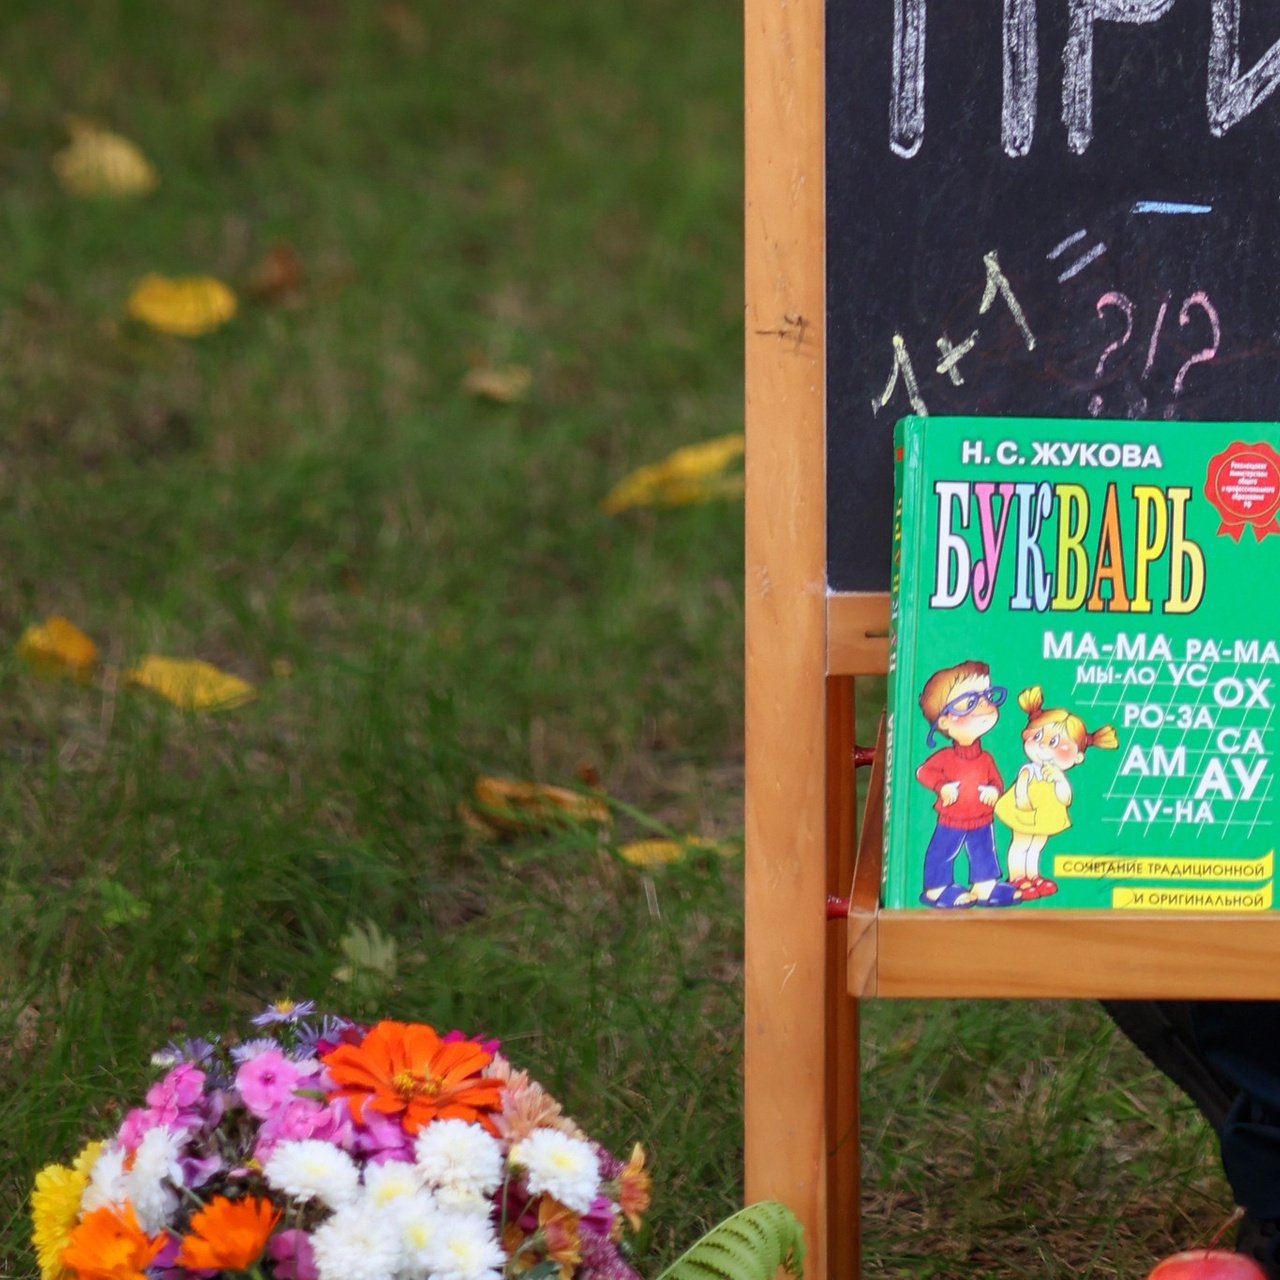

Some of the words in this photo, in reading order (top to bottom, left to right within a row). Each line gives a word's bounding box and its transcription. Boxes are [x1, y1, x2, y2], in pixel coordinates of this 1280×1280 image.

[961, 440, 990, 465] Н.
[995, 441, 1026, 466] С.
[1030, 442, 1164, 468] ЖУКОВА
[929, 480, 1206, 614] БУКВАРЬ
[1043, 631, 1172, 661] МА-МА
[1186, 639, 1280, 665] РА-МА
[1076, 665, 1156, 685] МЫ-ЛО
[1168, 663, 1208, 687] УС
[1213, 677, 1272, 709] ОХ
[1124, 704, 1215, 730] РО-ЗА
[1217, 727, 1266, 755] СА
[1121, 744, 1187, 777] АМ
[1194, 757, 1268, 801] АУ
[1122, 799, 1215, 824] ЛУ-НА
[1062, 860, 1143, 874] СОЧЕТАНИЕ
[1148, 862, 1265, 878] ТРАДИЦИОННОЙ
[1134, 893, 1144, 904] И
[1148, 892, 1264, 908] ОРИГИНАЛЬНОЙ
